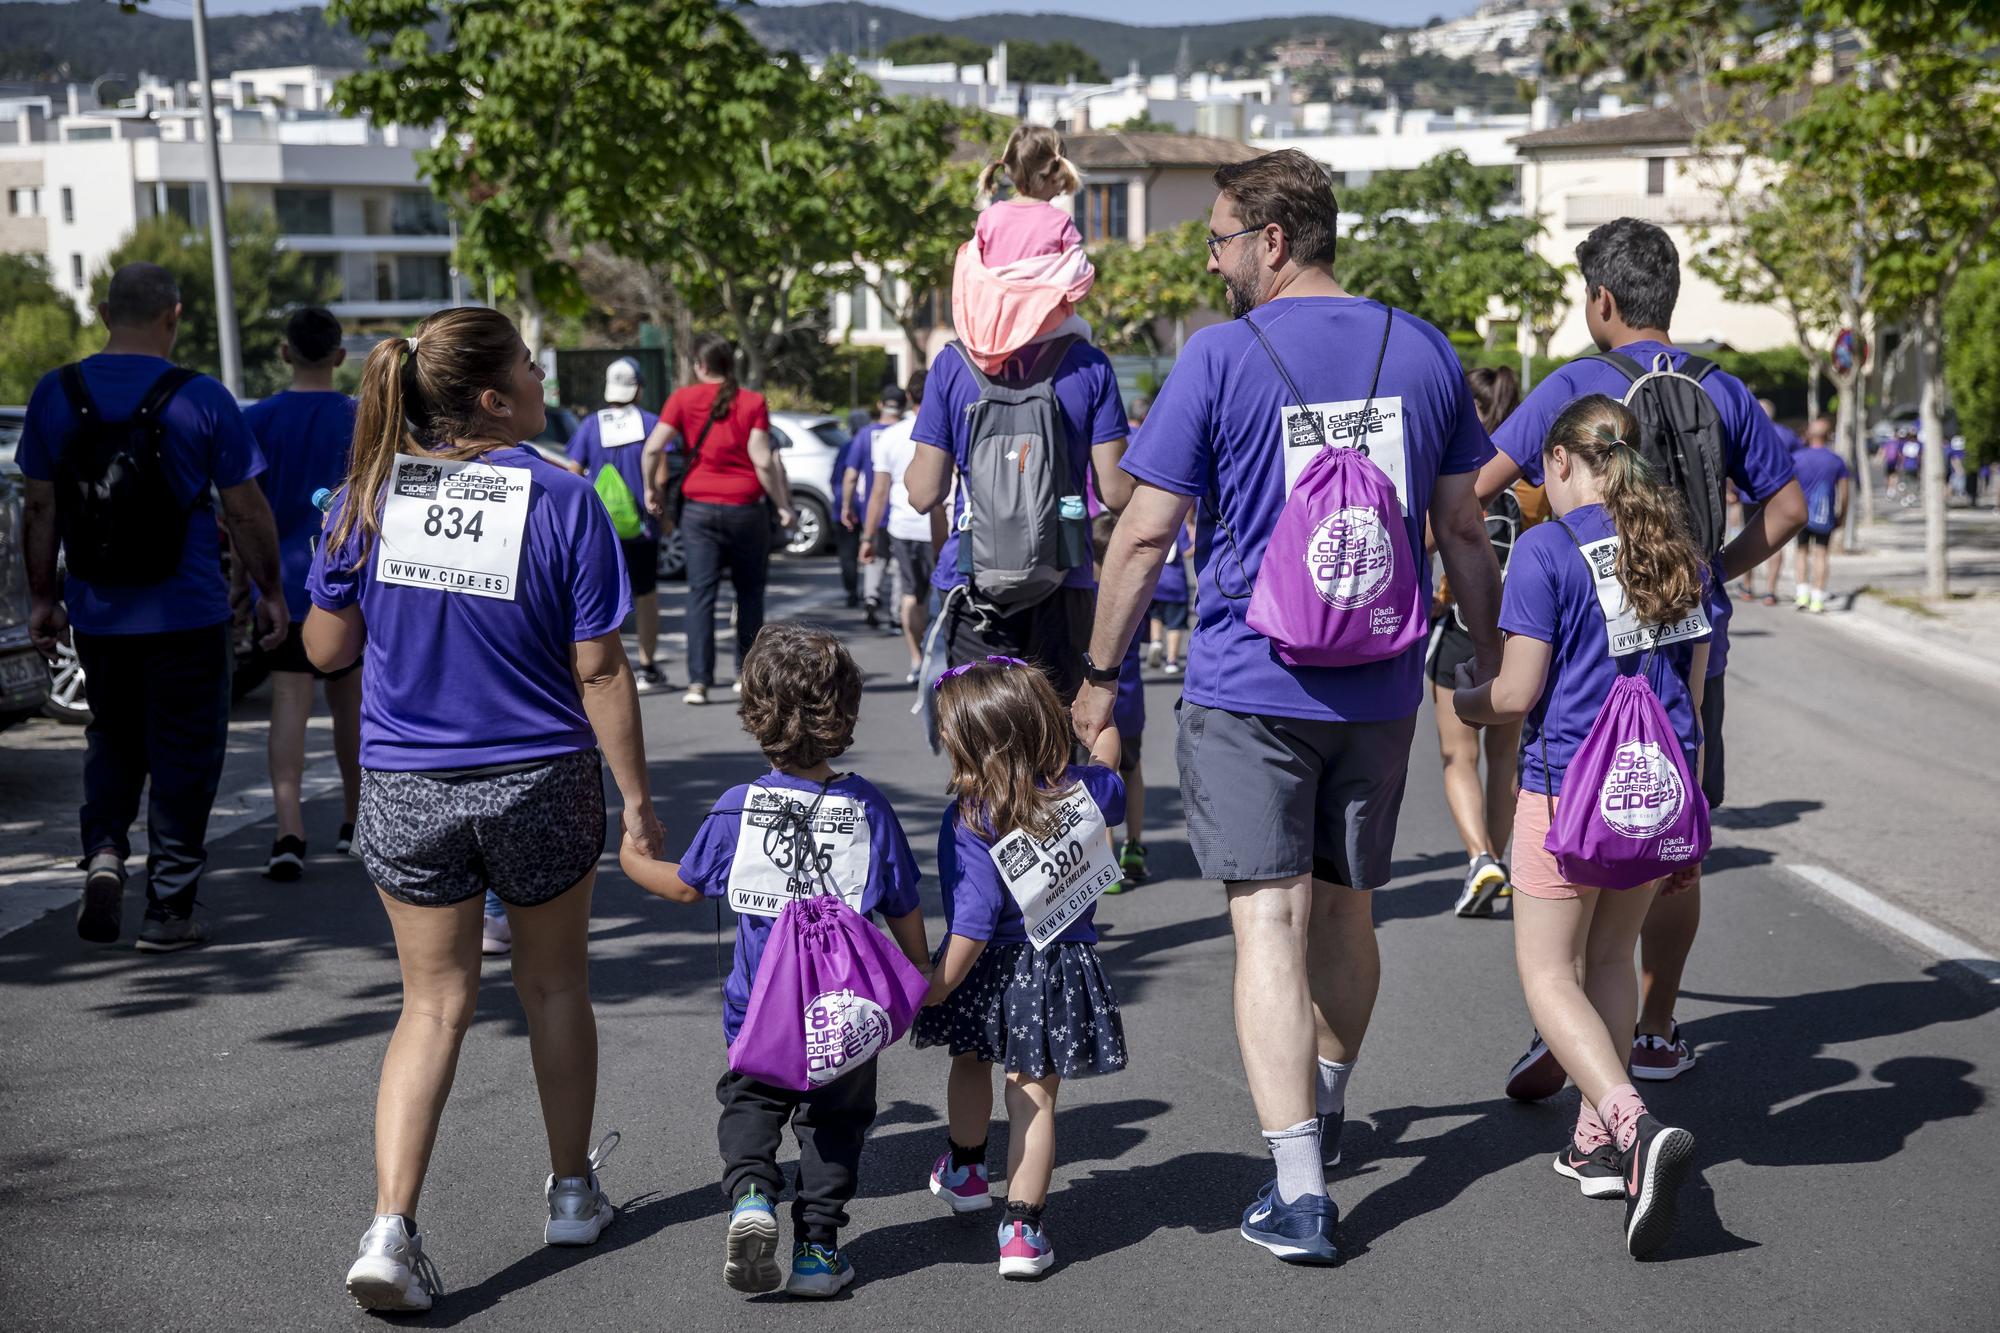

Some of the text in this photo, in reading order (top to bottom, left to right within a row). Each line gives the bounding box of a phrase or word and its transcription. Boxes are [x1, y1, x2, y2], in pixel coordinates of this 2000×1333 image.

[1329, 408, 1379, 423] CURSA
[1332, 421, 1383, 440] CIDE
[443, 481, 524, 492] COOPERATIVA
[447, 473, 507, 485] CURSA
[445, 488, 508, 503] CIDE
[424, 504, 484, 543] 834
[1318, 537, 1367, 554] CURSA
[390, 563, 502, 590] WWW.CIDE.ES
[1374, 606, 1394, 616] Cash
[1373, 615, 1403, 625] &Carry
[1372, 624, 1399, 635] Rotger
[1617, 619, 1699, 647] WWW.CDE.ES
[1615, 751, 1647, 770] 8a
[1605, 788, 1676, 811] CIDE22
[1041, 811, 1084, 853] CIDE
[1661, 843, 1695, 854] &Carry
[1663, 836, 1685, 846] Cash
[1041, 840, 1084, 890] 380
[1660, 852, 1690, 862] Rotger
[1037, 870, 1112, 937] WWW.CIDE.ES
